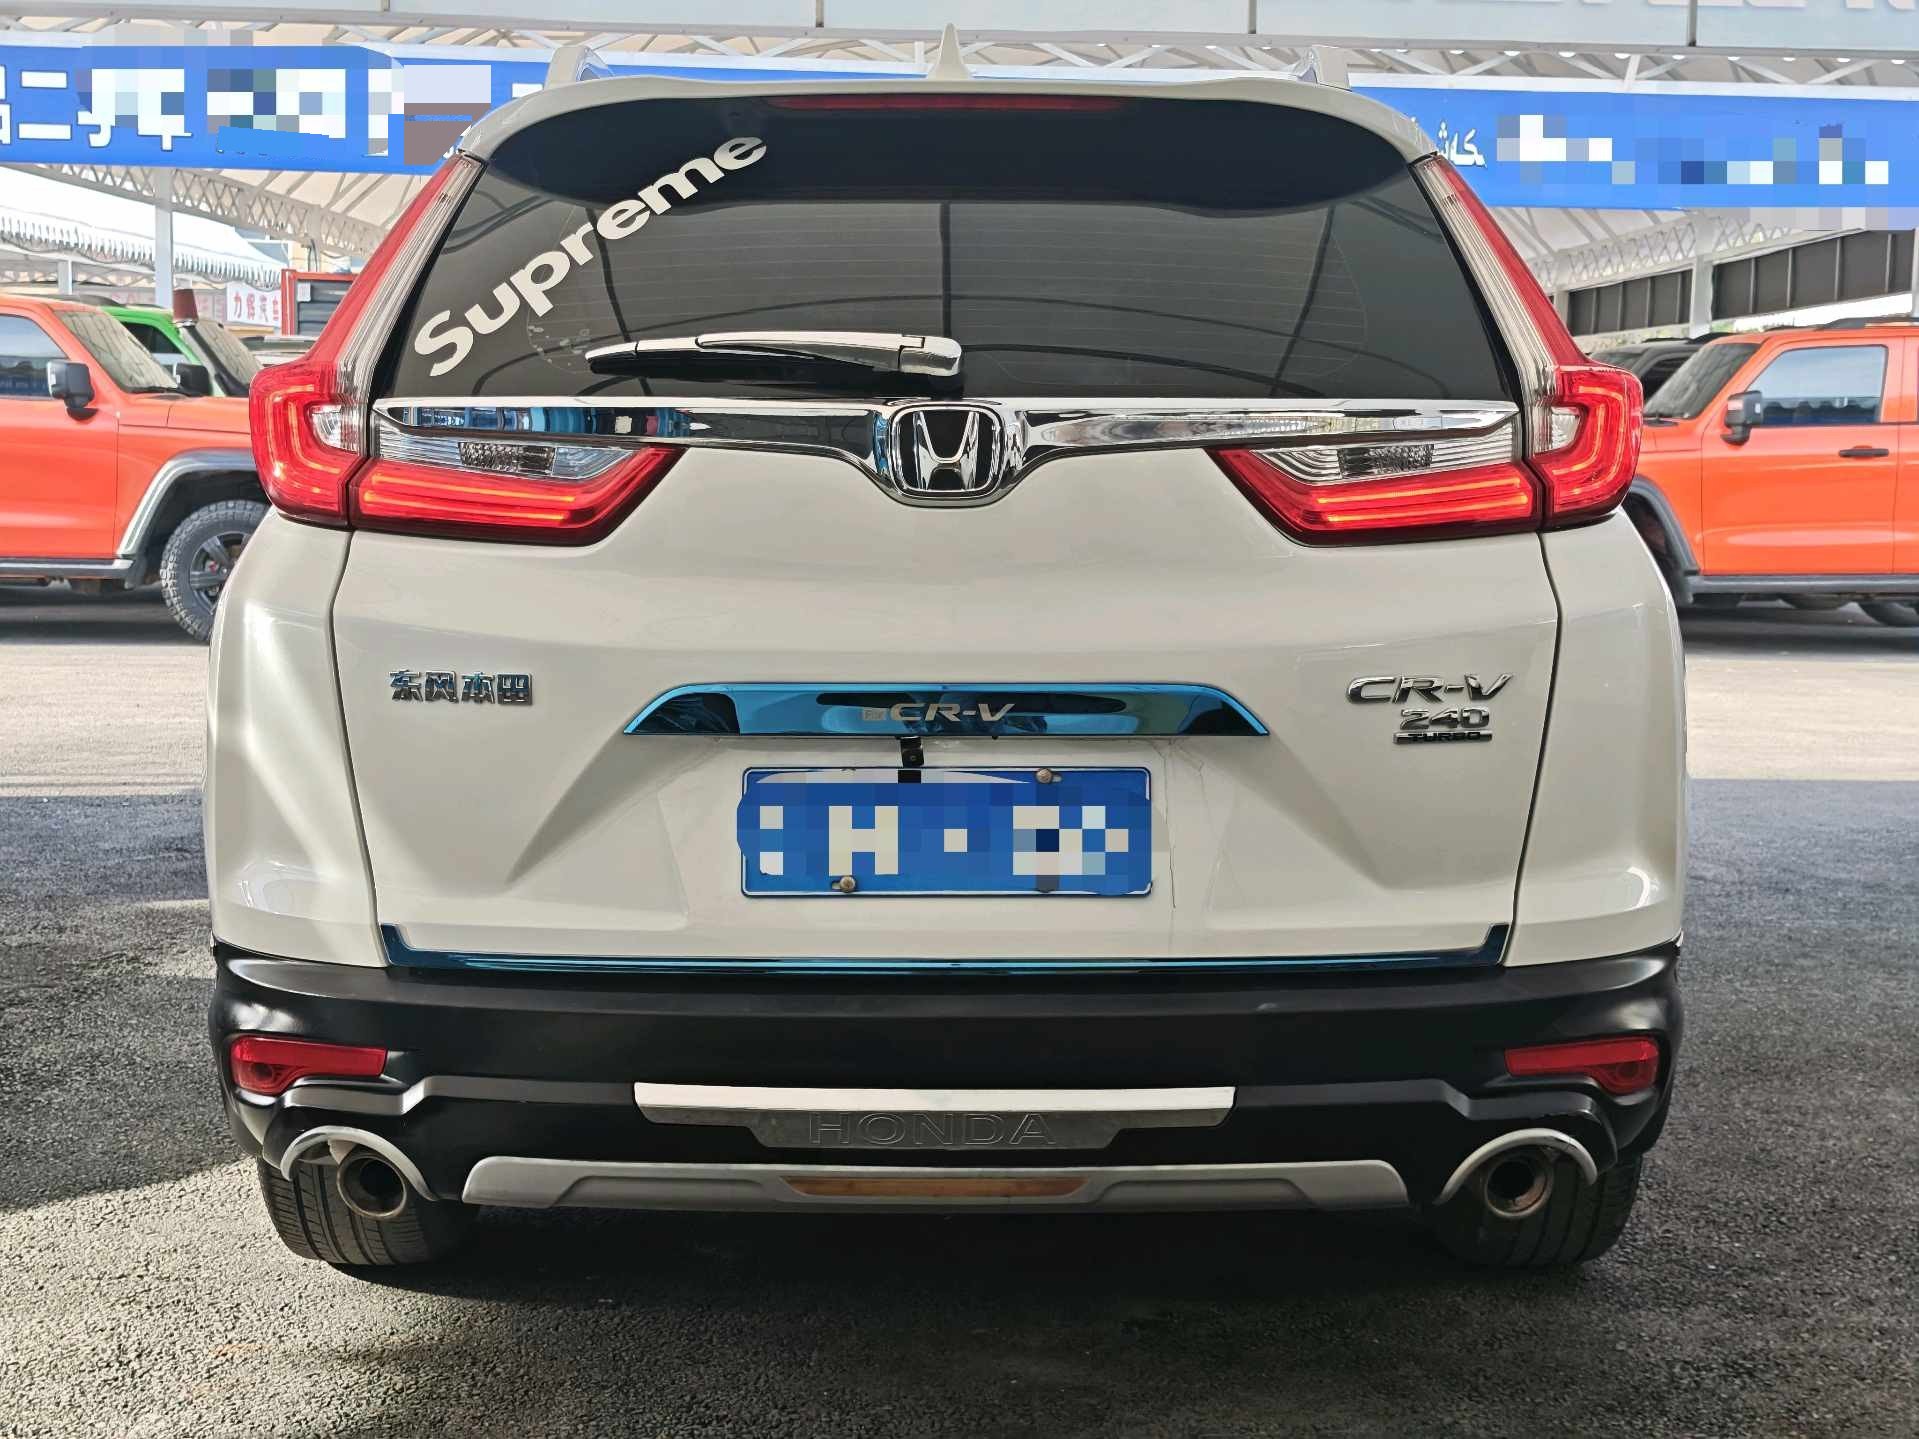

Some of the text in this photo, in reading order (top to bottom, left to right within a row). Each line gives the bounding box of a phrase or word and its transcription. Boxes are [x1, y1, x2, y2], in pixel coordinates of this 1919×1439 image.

[414, 136, 767, 377] Supreme
[1346, 674, 1513, 704] CR-V
[890, 702, 1016, 722] CR-V
[1400, 706, 1490, 730] 240
[809, 1112, 1056, 1145] HONDA
